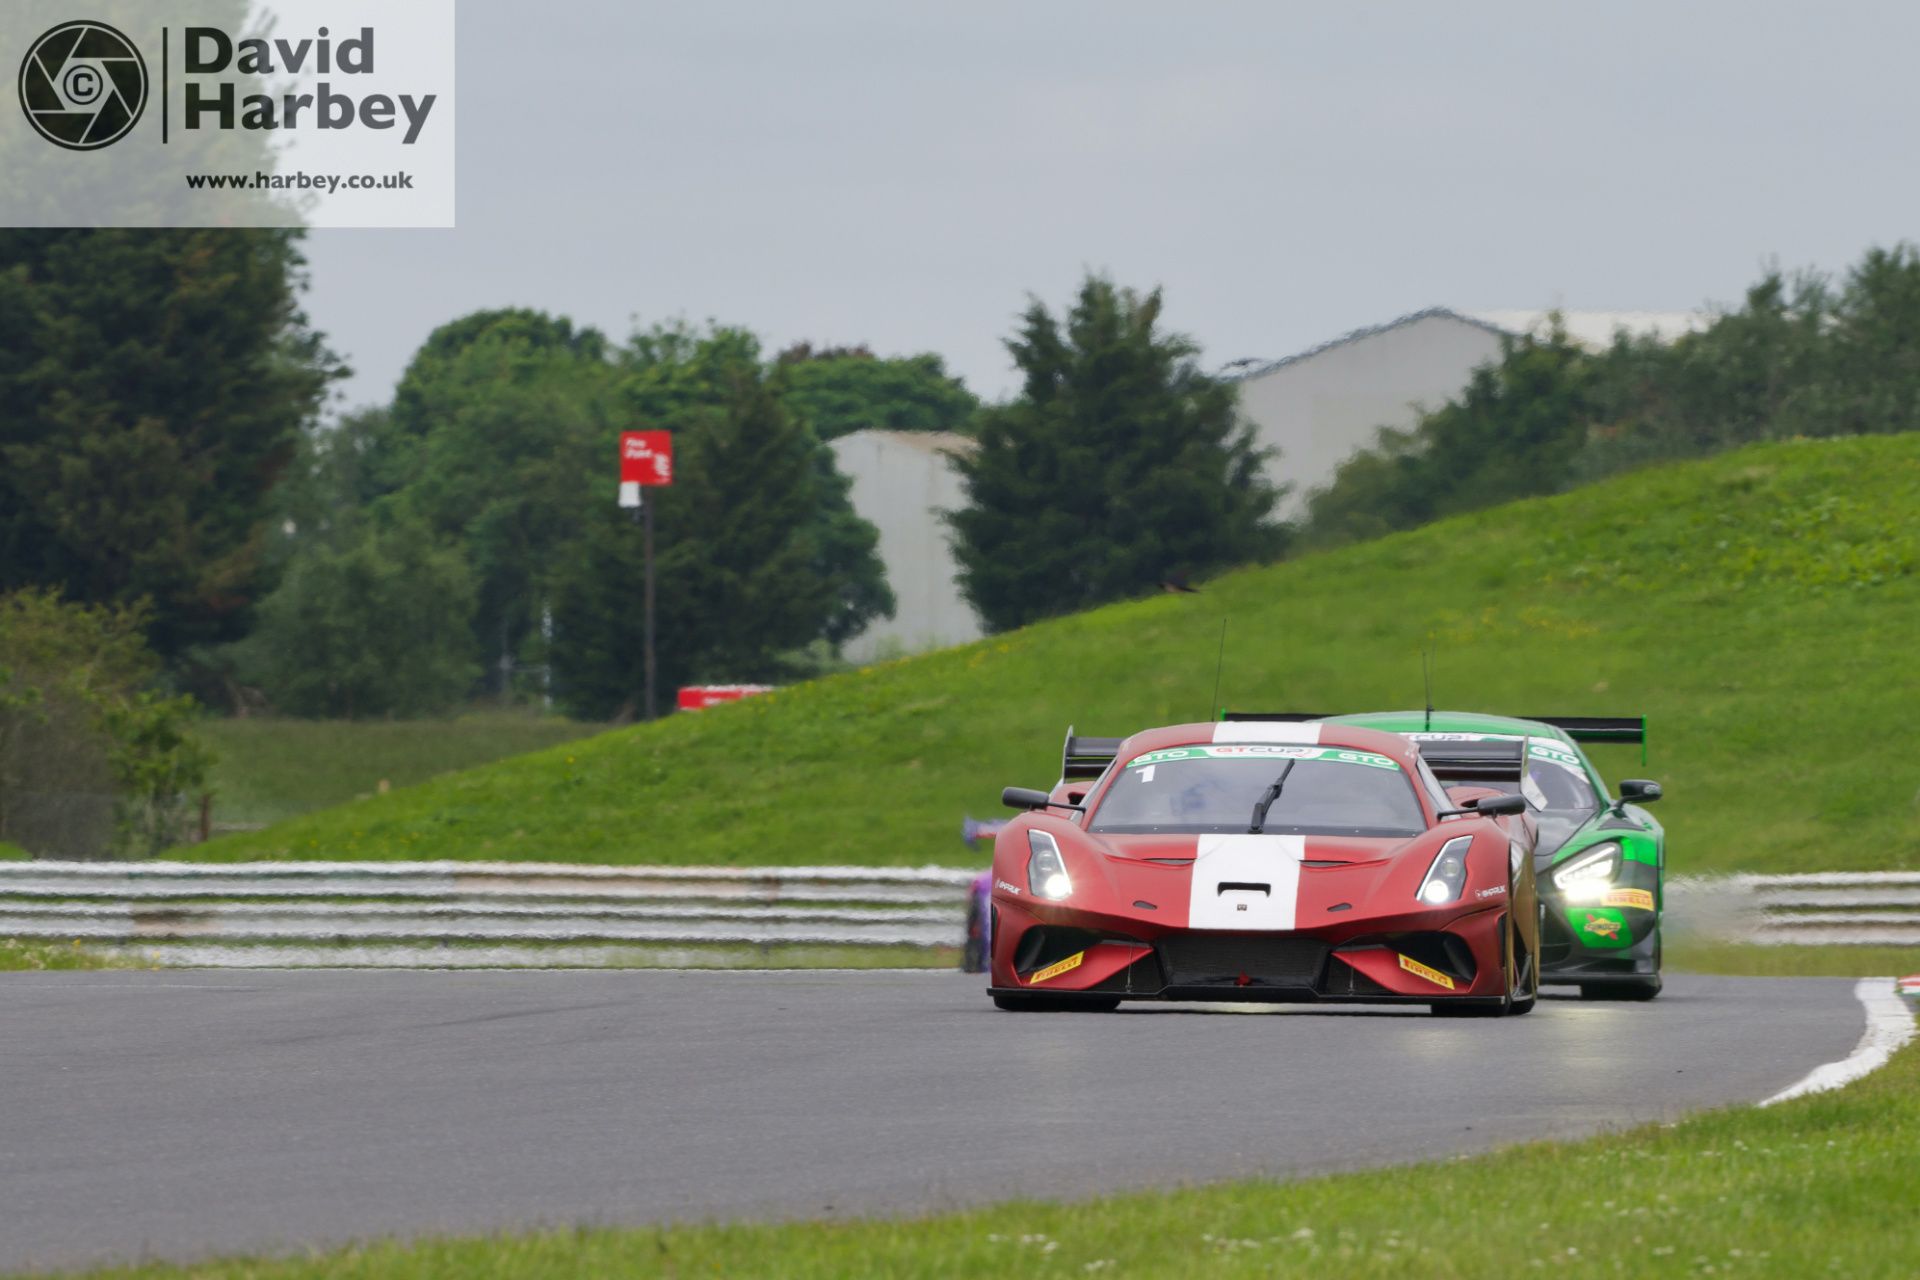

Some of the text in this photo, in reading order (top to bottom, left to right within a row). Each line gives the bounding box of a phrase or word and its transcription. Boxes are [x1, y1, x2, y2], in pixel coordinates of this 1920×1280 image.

[1338, 752, 1394, 766] GTO
[1530, 746, 1580, 765] GTO
[1135, 764, 1156, 783] 1
